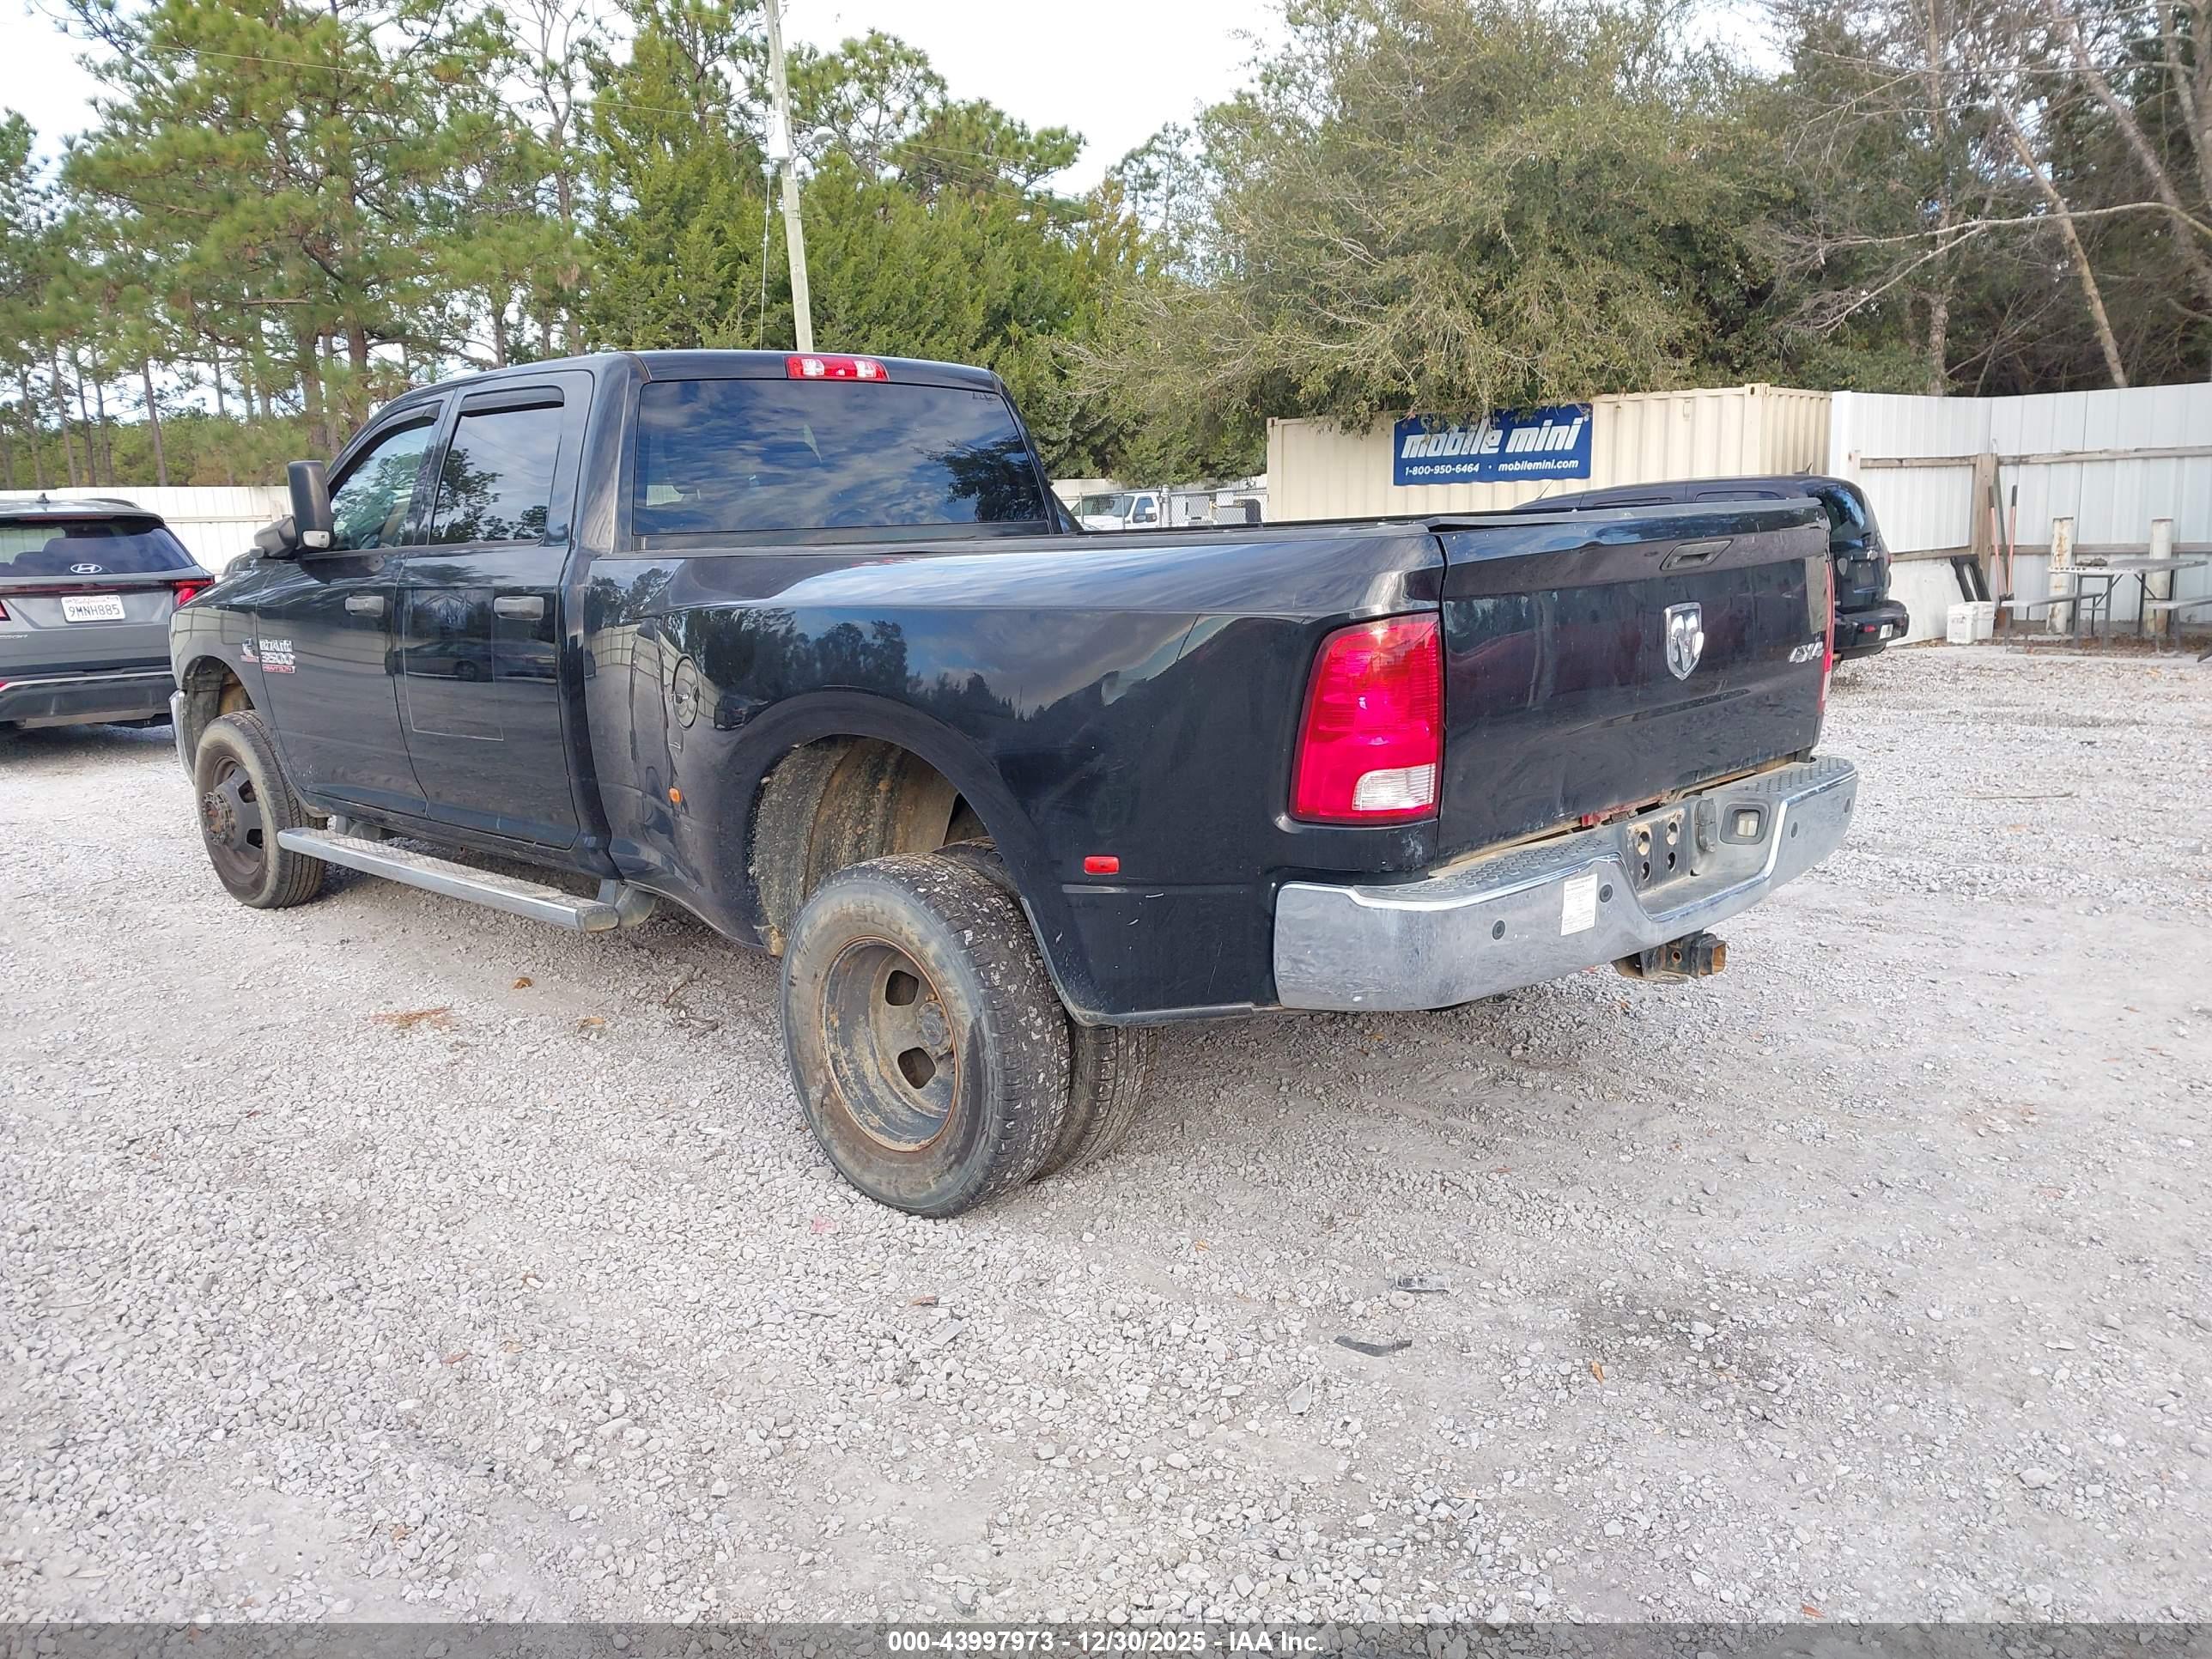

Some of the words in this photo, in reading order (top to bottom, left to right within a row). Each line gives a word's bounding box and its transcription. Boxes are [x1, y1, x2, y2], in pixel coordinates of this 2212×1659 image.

[1401, 417, 1504, 459] mobile
[1504, 417, 1583, 453] mini
[1404, 463, 1480, 477] 1-800-950-6464
[1498, 459, 1579, 472] mobilemini.com
[68, 604, 121, 617] 9MNH885
